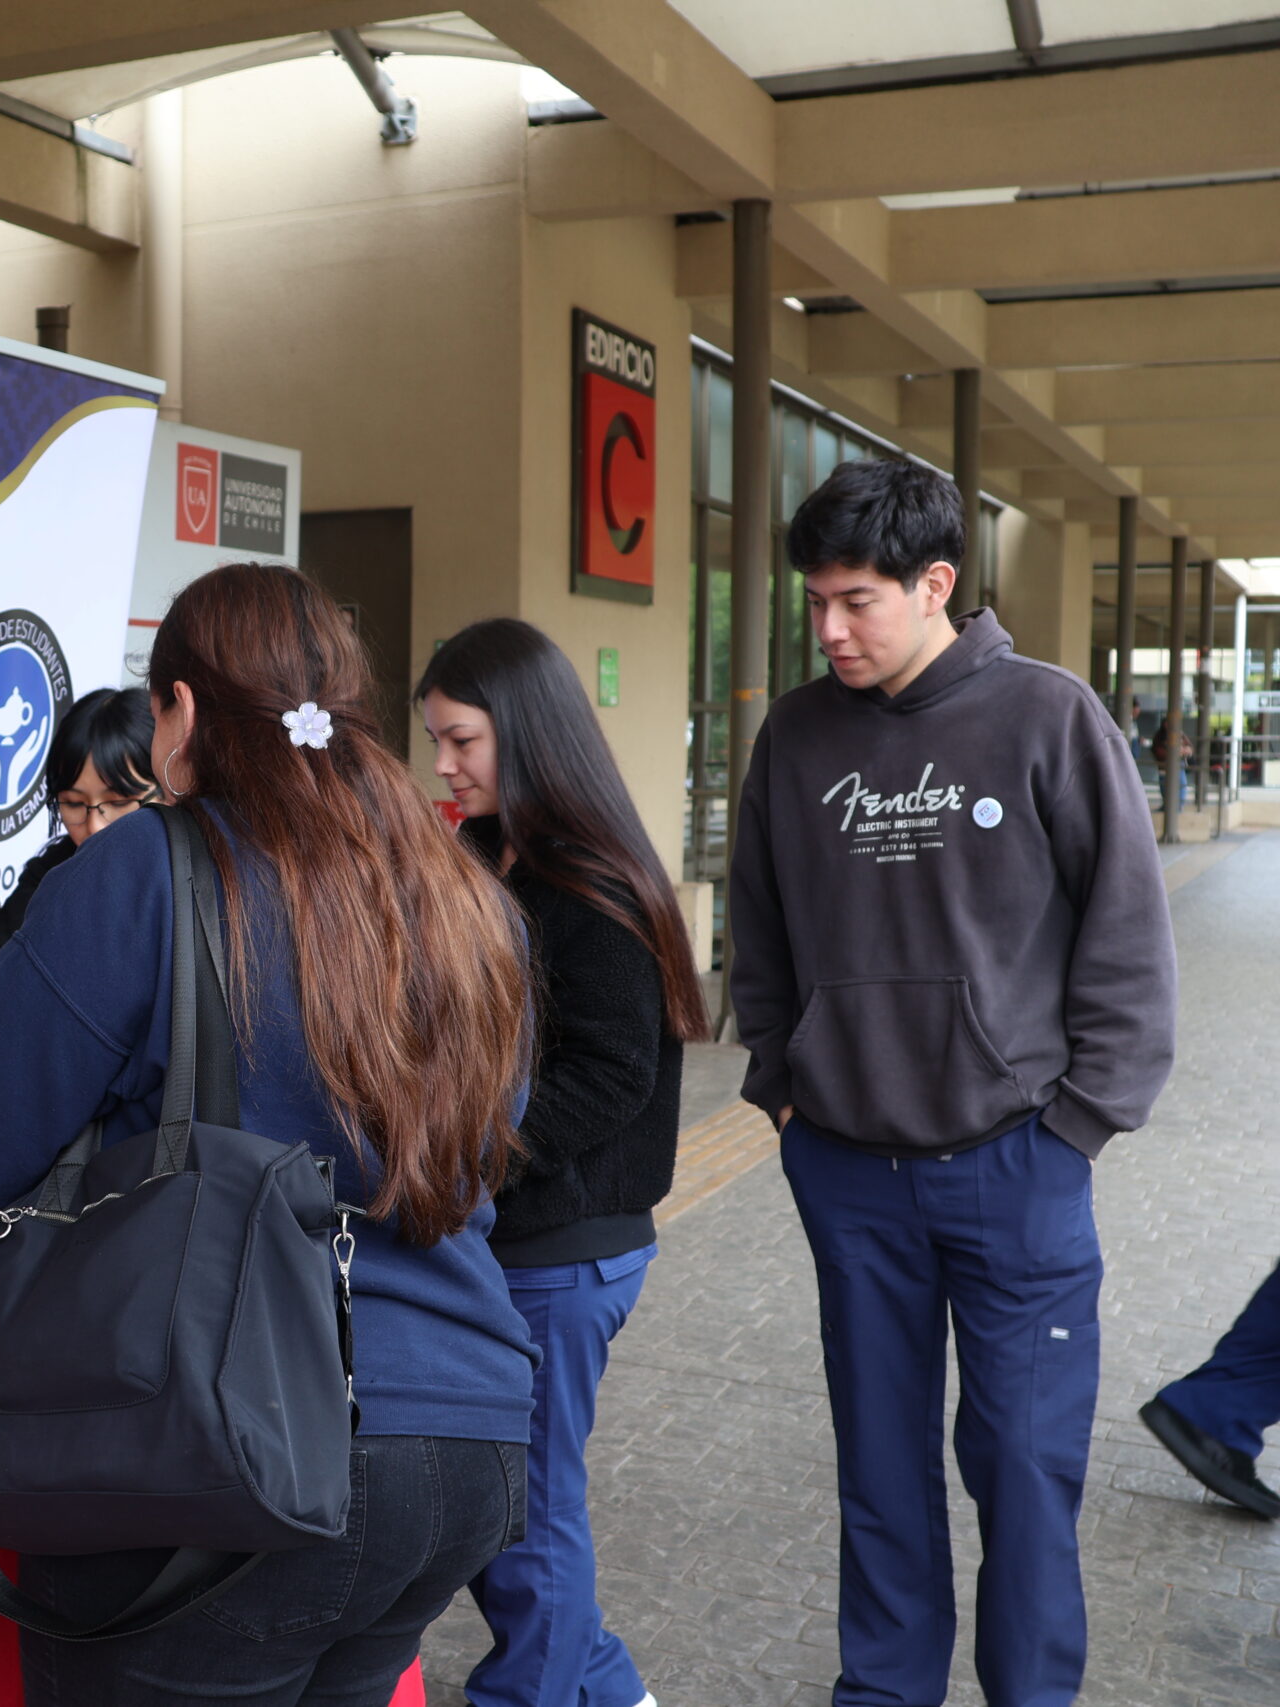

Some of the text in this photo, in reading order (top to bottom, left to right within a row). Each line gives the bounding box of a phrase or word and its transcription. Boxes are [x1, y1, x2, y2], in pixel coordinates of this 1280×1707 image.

[586, 322, 654, 388] EDIFICIO
[601, 411, 646, 555] C
[244, 515, 280, 533] CHILE
[822, 762, 962, 832] Fender
[1, 815, 16, 835] UA
[857, 821, 892, 833] ELECTRIC
